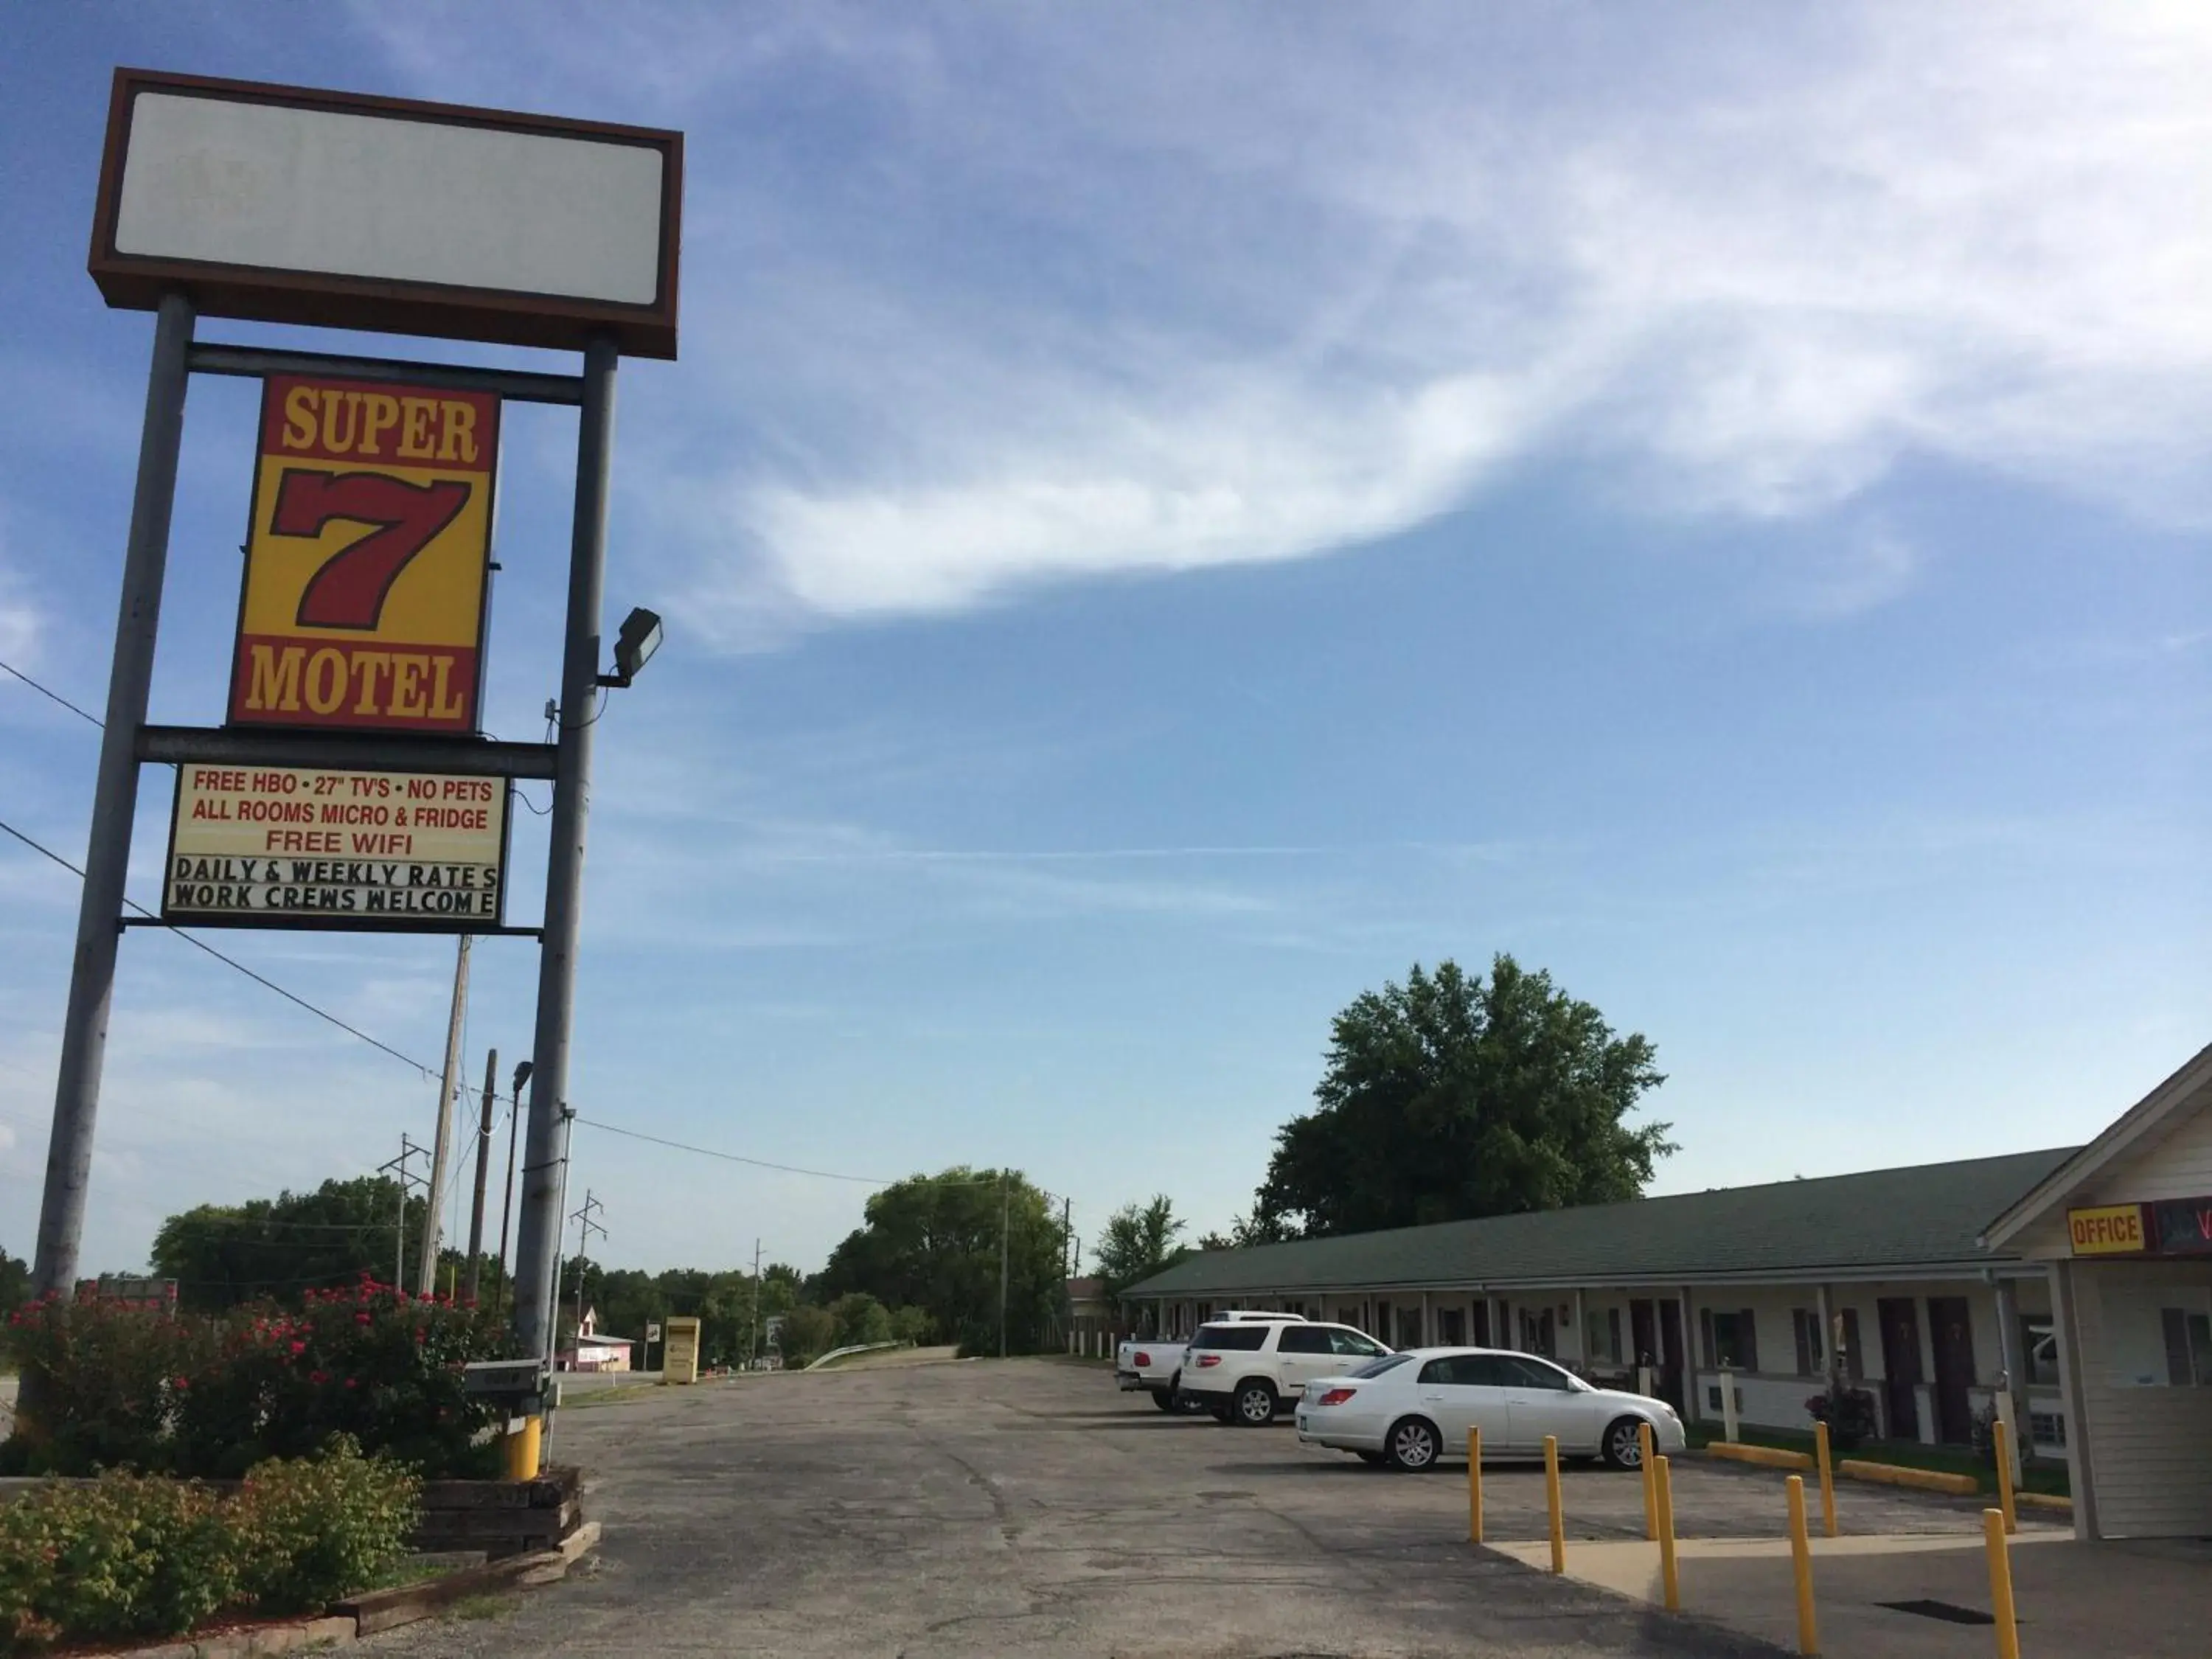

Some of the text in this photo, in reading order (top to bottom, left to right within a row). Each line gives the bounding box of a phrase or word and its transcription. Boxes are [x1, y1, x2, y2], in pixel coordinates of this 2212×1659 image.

[282, 386, 479, 463] SUPER
[269, 467, 472, 632] 7
[246, 645, 463, 720] MOTEL
[193, 771, 247, 791] FREE
[252, 773, 297, 794] HBO
[350, 777, 390, 798] TV'S
[408, 779, 437, 799] NO
[442, 781, 492, 801] PETS
[192, 799, 488, 830] ALL ROOMS MICRO & FRIDGE
[266, 830, 412, 855] FREE WIFI
[176, 858, 495, 888] DAILY & WEEKLY RATES
[175, 885, 251, 907] WORK
[265, 886, 355, 911] CREWS
[2074, 1214, 2139, 1245] OFFICE
